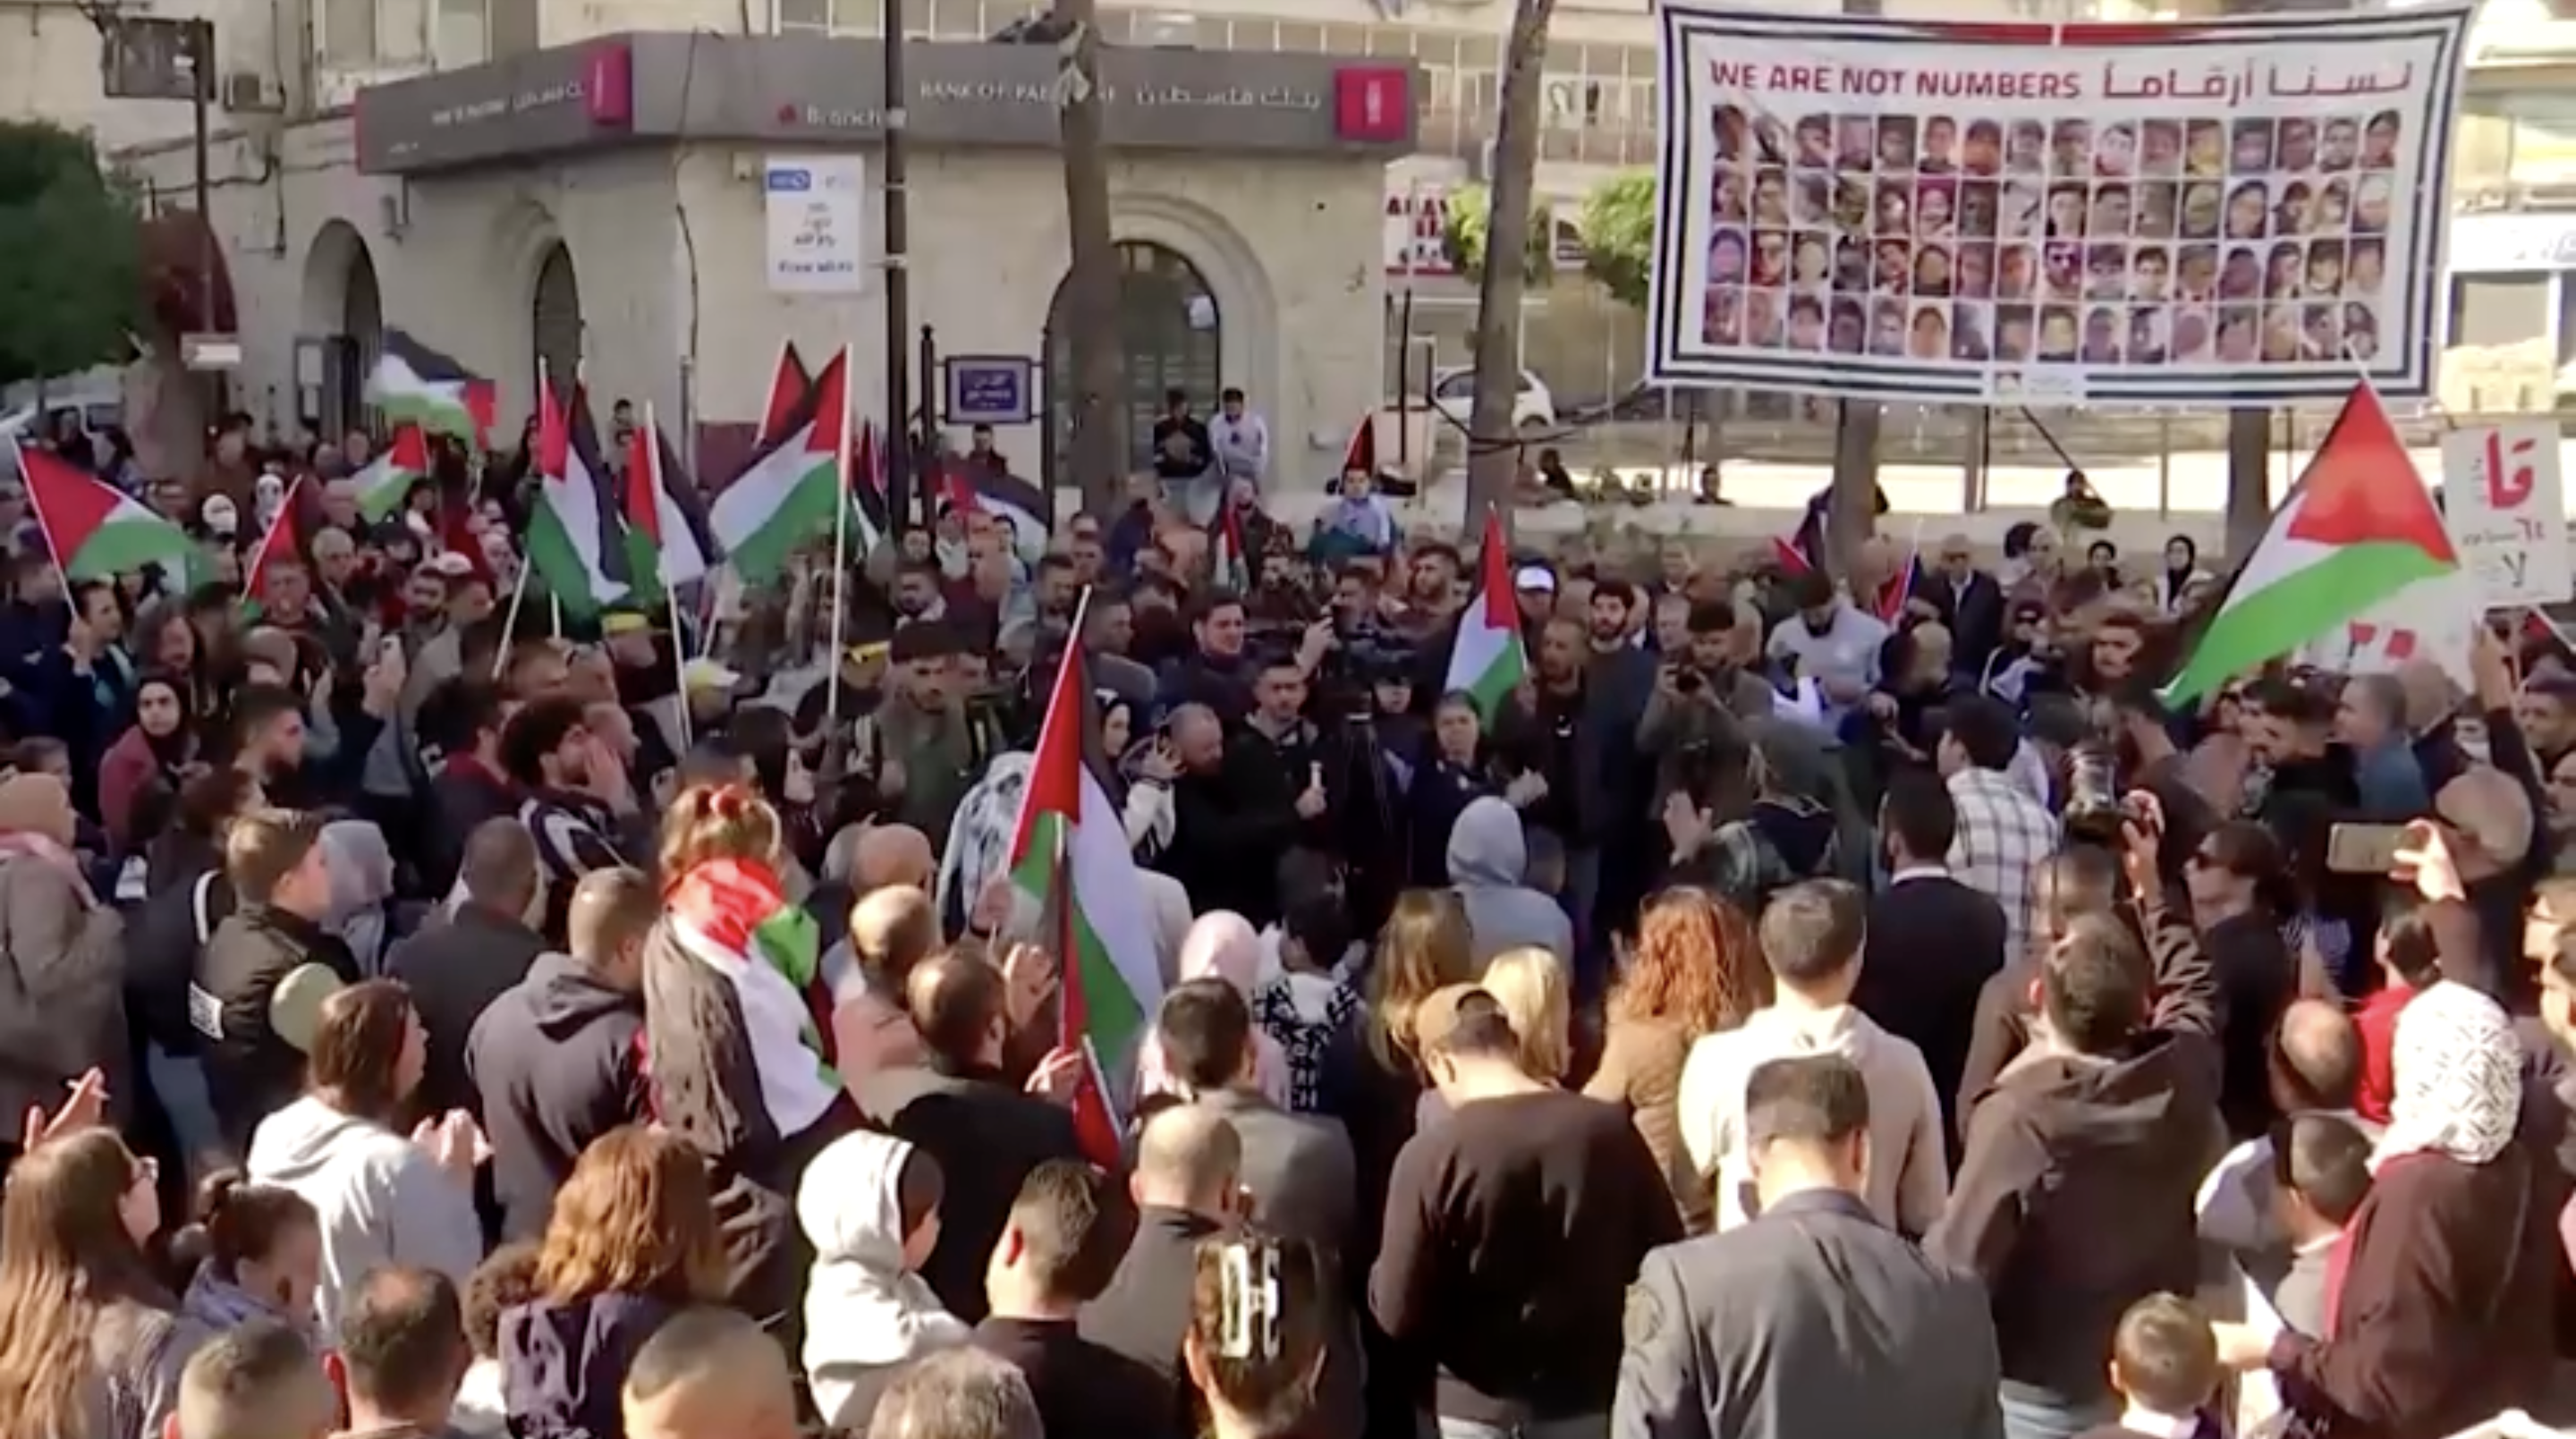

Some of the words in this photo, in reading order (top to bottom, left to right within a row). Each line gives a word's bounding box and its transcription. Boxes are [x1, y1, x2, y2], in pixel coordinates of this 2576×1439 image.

[1710, 60, 1758, 89] WE
[1767, 64, 1832, 93] ARE
[1841, 67, 1908, 96] NOT
[1916, 71, 2082, 99] NUMBERS
[2267, 61, 2413, 97] لسنا
